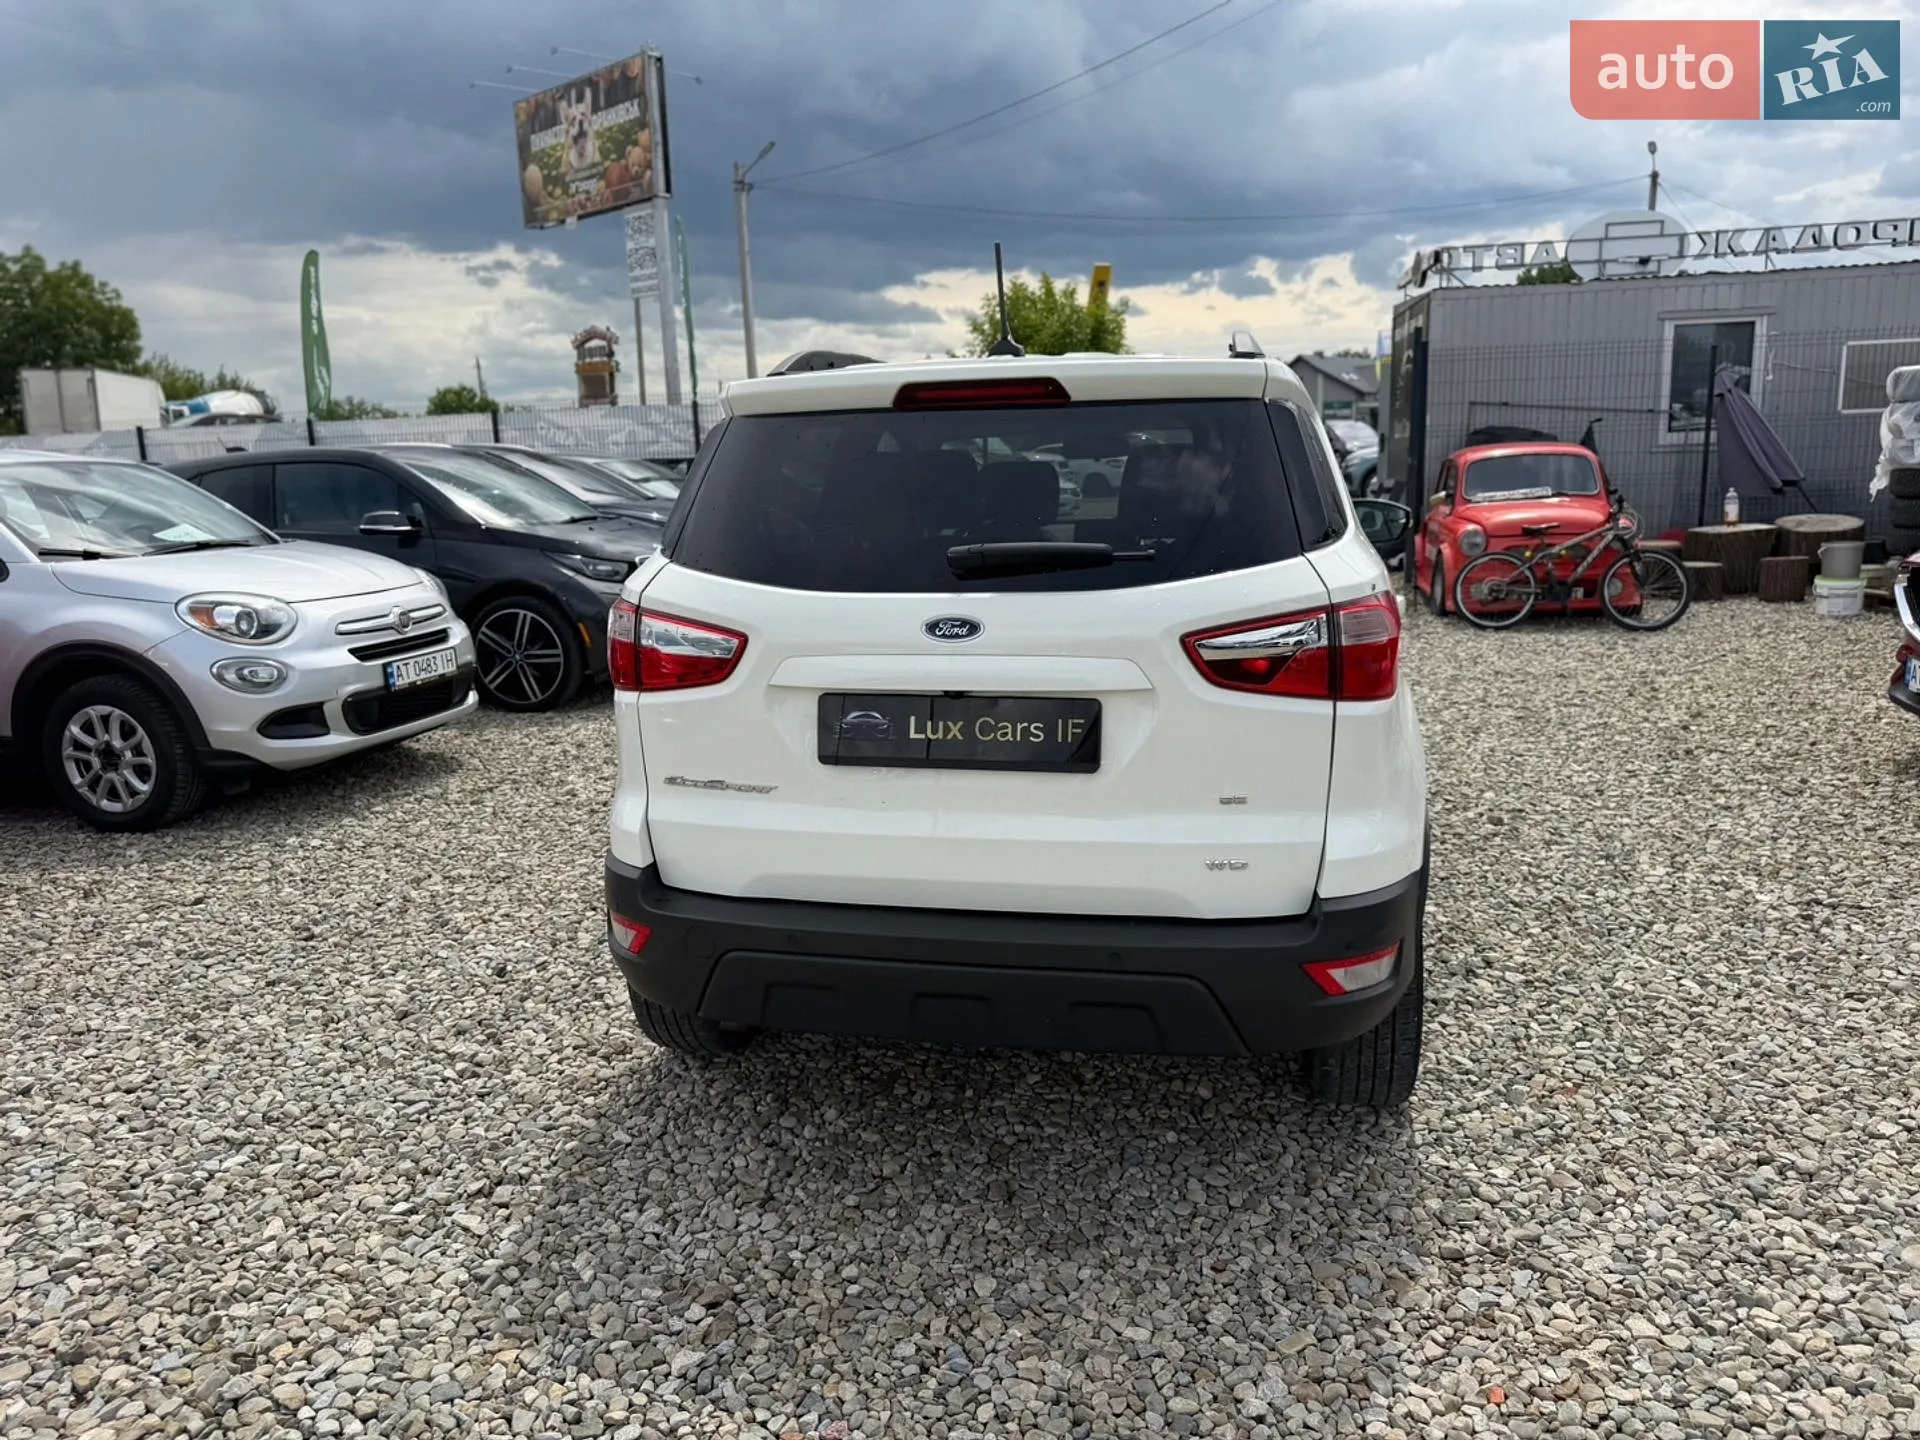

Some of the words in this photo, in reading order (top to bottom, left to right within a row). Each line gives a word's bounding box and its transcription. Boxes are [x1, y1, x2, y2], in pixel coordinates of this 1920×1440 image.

[935, 621, 970, 636] Ford
[396, 662, 411, 682] AT
[413, 656, 439, 677] 0483
[440, 652, 455, 671] IH
[909, 716, 964, 741] Lux
[974, 717, 1045, 742] Cars
[1057, 719, 1086, 743] IF
